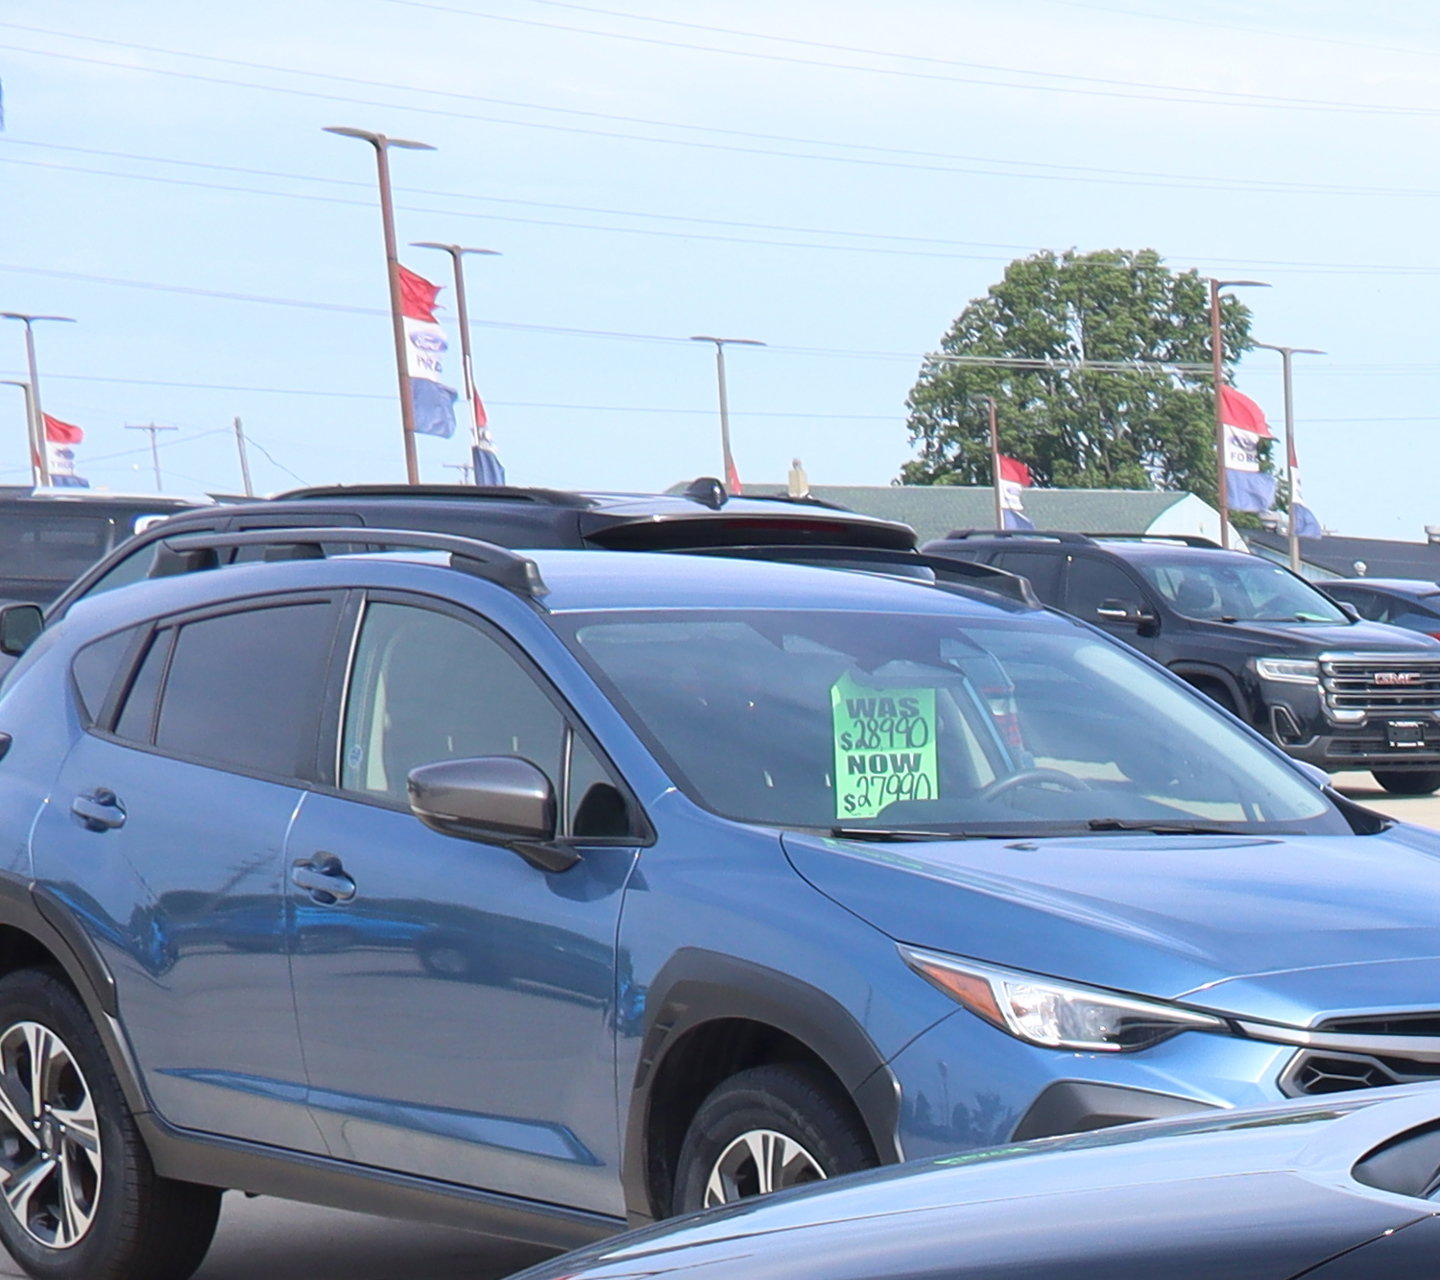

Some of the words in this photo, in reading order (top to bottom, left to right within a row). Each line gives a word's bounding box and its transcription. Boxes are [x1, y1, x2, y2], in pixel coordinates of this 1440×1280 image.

[846, 697, 921, 719] WAS
[847, 752, 922, 775] NOW
[843, 772, 932, 813] $27990
